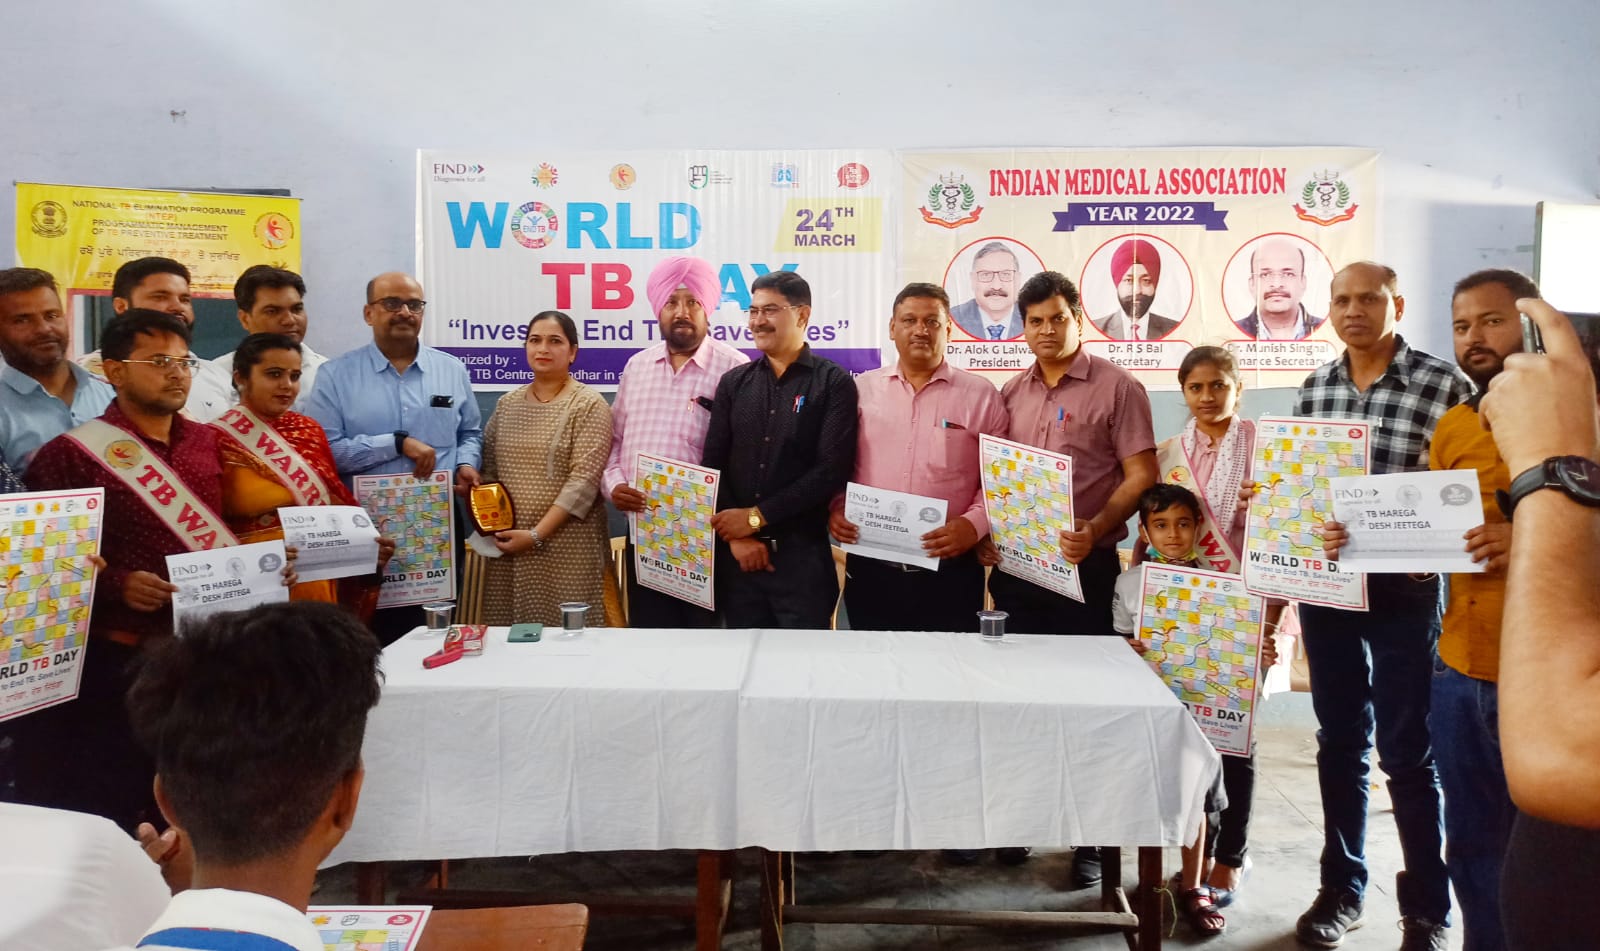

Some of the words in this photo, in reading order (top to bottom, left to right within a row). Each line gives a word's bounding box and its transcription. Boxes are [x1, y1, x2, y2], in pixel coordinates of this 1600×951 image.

[433, 163, 467, 175] FIND
[989, 168, 1060, 197] INDIAN
[1064, 168, 1151, 196] MEDICAL
[1154, 167, 1287, 195] ASSOCIATION
[72, 200, 118, 210] NATIONAL
[134, 203, 188, 213] ELIMINATION
[190, 206, 247, 217] PROGRAMME
[1086, 206, 1138, 222] YEAR
[1144, 205, 1195, 221] 2022
[166, 222, 228, 233] MANAGEMENT
[523, 225, 536, 233] END
[537, 225, 546, 233] TB
[121, 230, 176, 239] PREVENTIVE
[178, 232, 228, 241] TREATMENT
[794, 234, 856, 247] MARCH
[541, 263, 635, 310] TB
[584, 319, 633, 341] End
[946, 345, 962, 354] Dr.
[964, 344, 990, 354] Alok
[992, 345, 1000, 354] G
[1108, 344, 1124, 353] Dr.
[1126, 344, 1134, 353] R
[1136, 344, 1144, 353] S
[1146, 344, 1163, 353] Bal
[1246, 343, 1287, 353] Munish
[1289, 343, 1329, 356] Singhal
[495, 354, 509, 367] by
[969, 358, 1022, 368] President
[1109, 356, 1162, 368] Secretary
[1239, 358, 1272, 367] nance
[474, 369, 491, 380] TB
[604, 369, 616, 380] in
[217, 409, 255, 436] TB
[136, 464, 178, 506] TB
[848, 491, 869, 502] FIND
[1335, 488, 1364, 499] FIND
[866, 511, 874, 519] TB
[875, 513, 902, 523] HAREGA
[1366, 510, 1377, 518] TB
[1379, 509, 1417, 517] HAREGA
[864, 520, 881, 529] DESH
[882, 523, 910, 533] JEETEGA
[1368, 522, 1391, 530] DESH
[1393, 520, 1432, 529] JEETEGA
[317, 530, 342, 538] HAREGA
[172, 564, 199, 577] FIND
[1034, 557, 1049, 568] TB
[1051, 563, 1072, 577] DAY
[1302, 559, 1323, 570] TB
[408, 571, 424, 580] TB
[427, 569, 448, 578] DAY
[674, 566, 687, 577] TB
[690, 571, 708, 583] DAY
[201, 583, 211, 592] TB
[213, 579, 242, 590] HAREGA
[202, 594, 221, 603] DESH
[223, 588, 251, 600] JEETEGA
[32, 656, 50, 671] TB
[53, 649, 79, 666] DAY
[1194, 704, 1213, 717] TB
[1217, 709, 1246, 723] DAY
